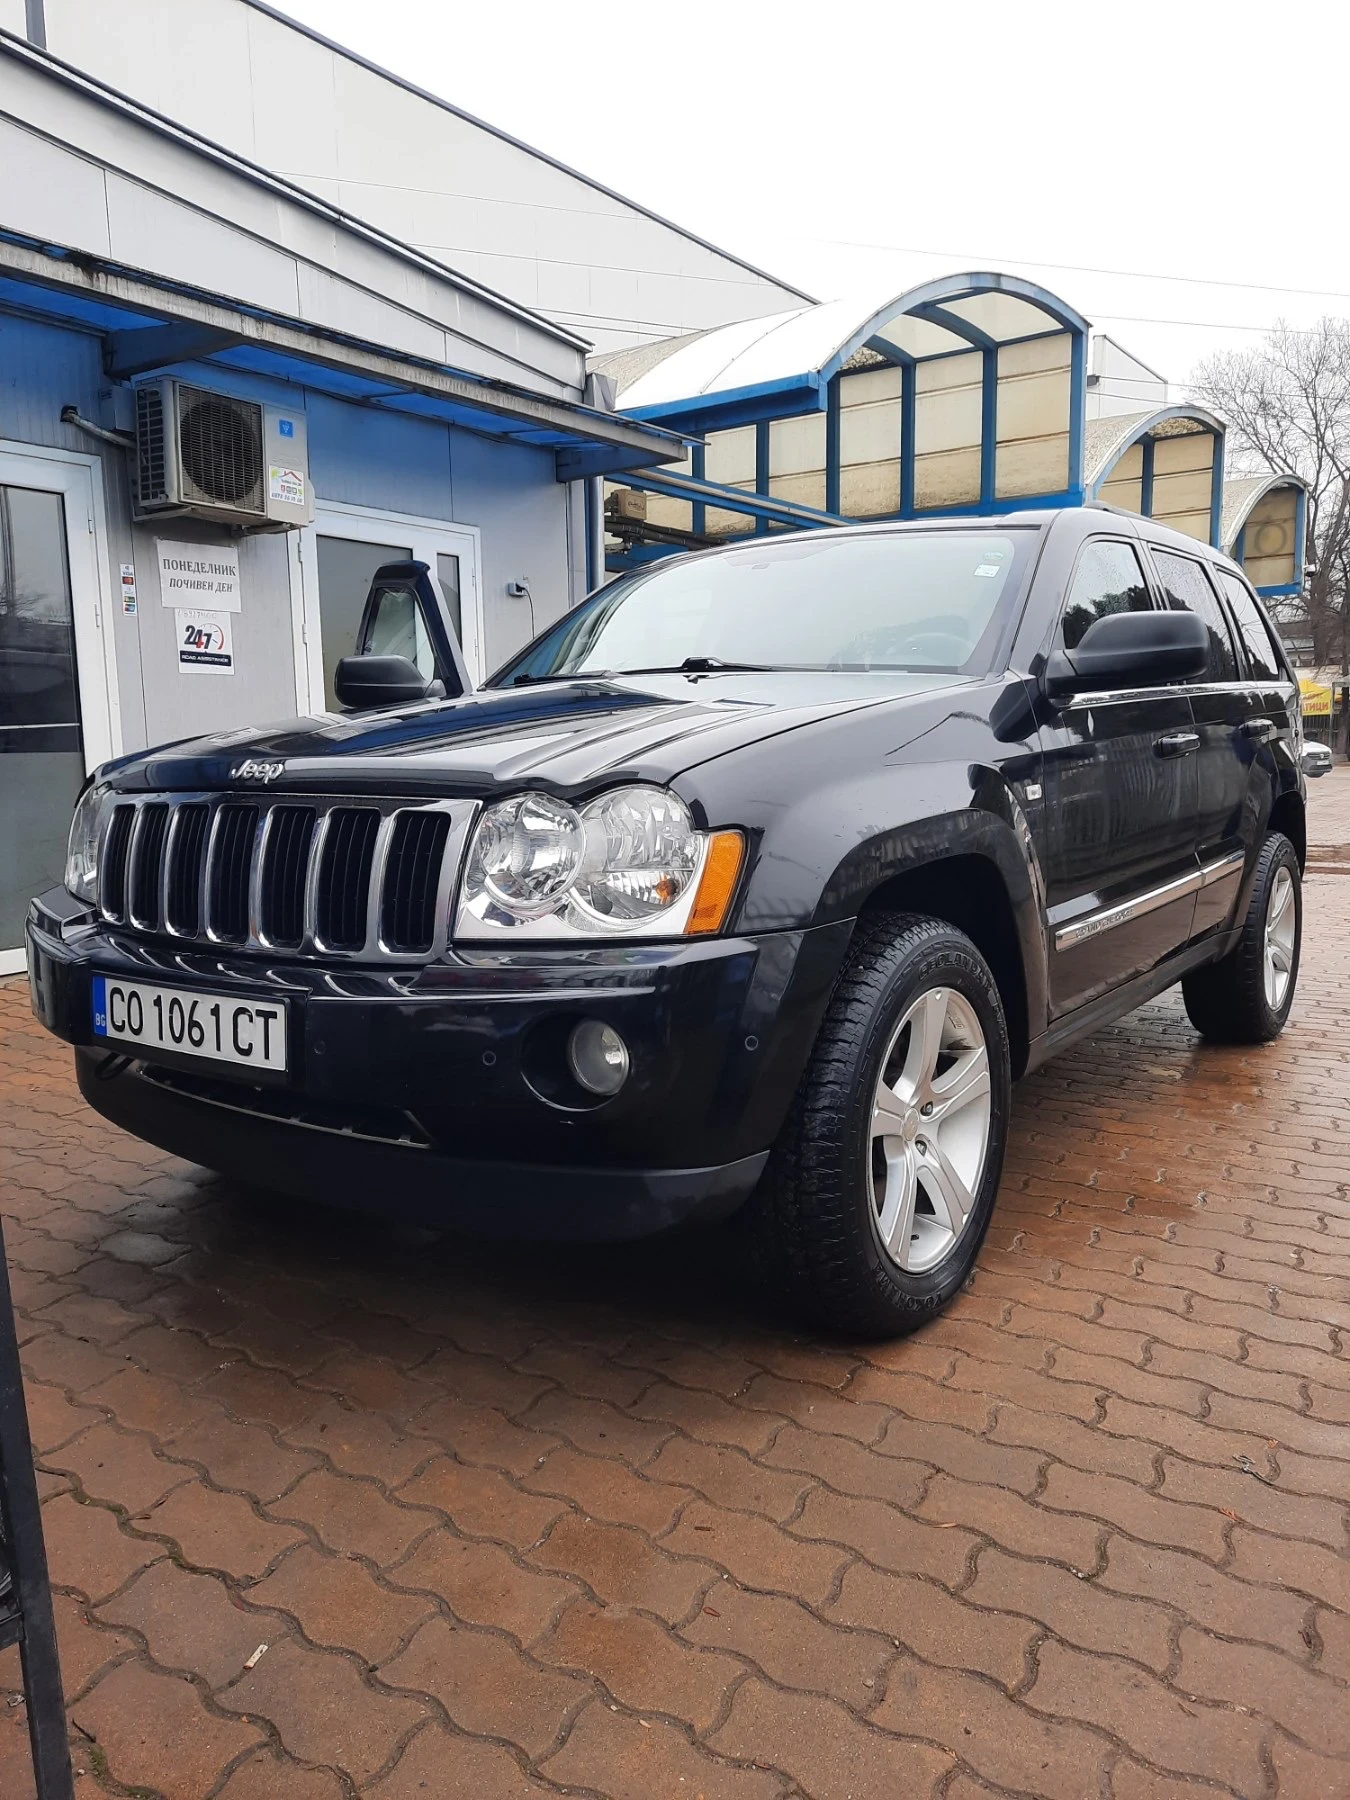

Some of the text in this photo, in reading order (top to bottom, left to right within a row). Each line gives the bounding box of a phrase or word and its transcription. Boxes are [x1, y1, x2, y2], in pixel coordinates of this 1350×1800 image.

[163, 558, 236, 576] ПОНЕДЕЛНИК
[169, 578, 233, 594] ПОЧИВЕН ДЕН
[231, 759, 284, 785] Jeep
[95, 1013, 106, 1027] BG
